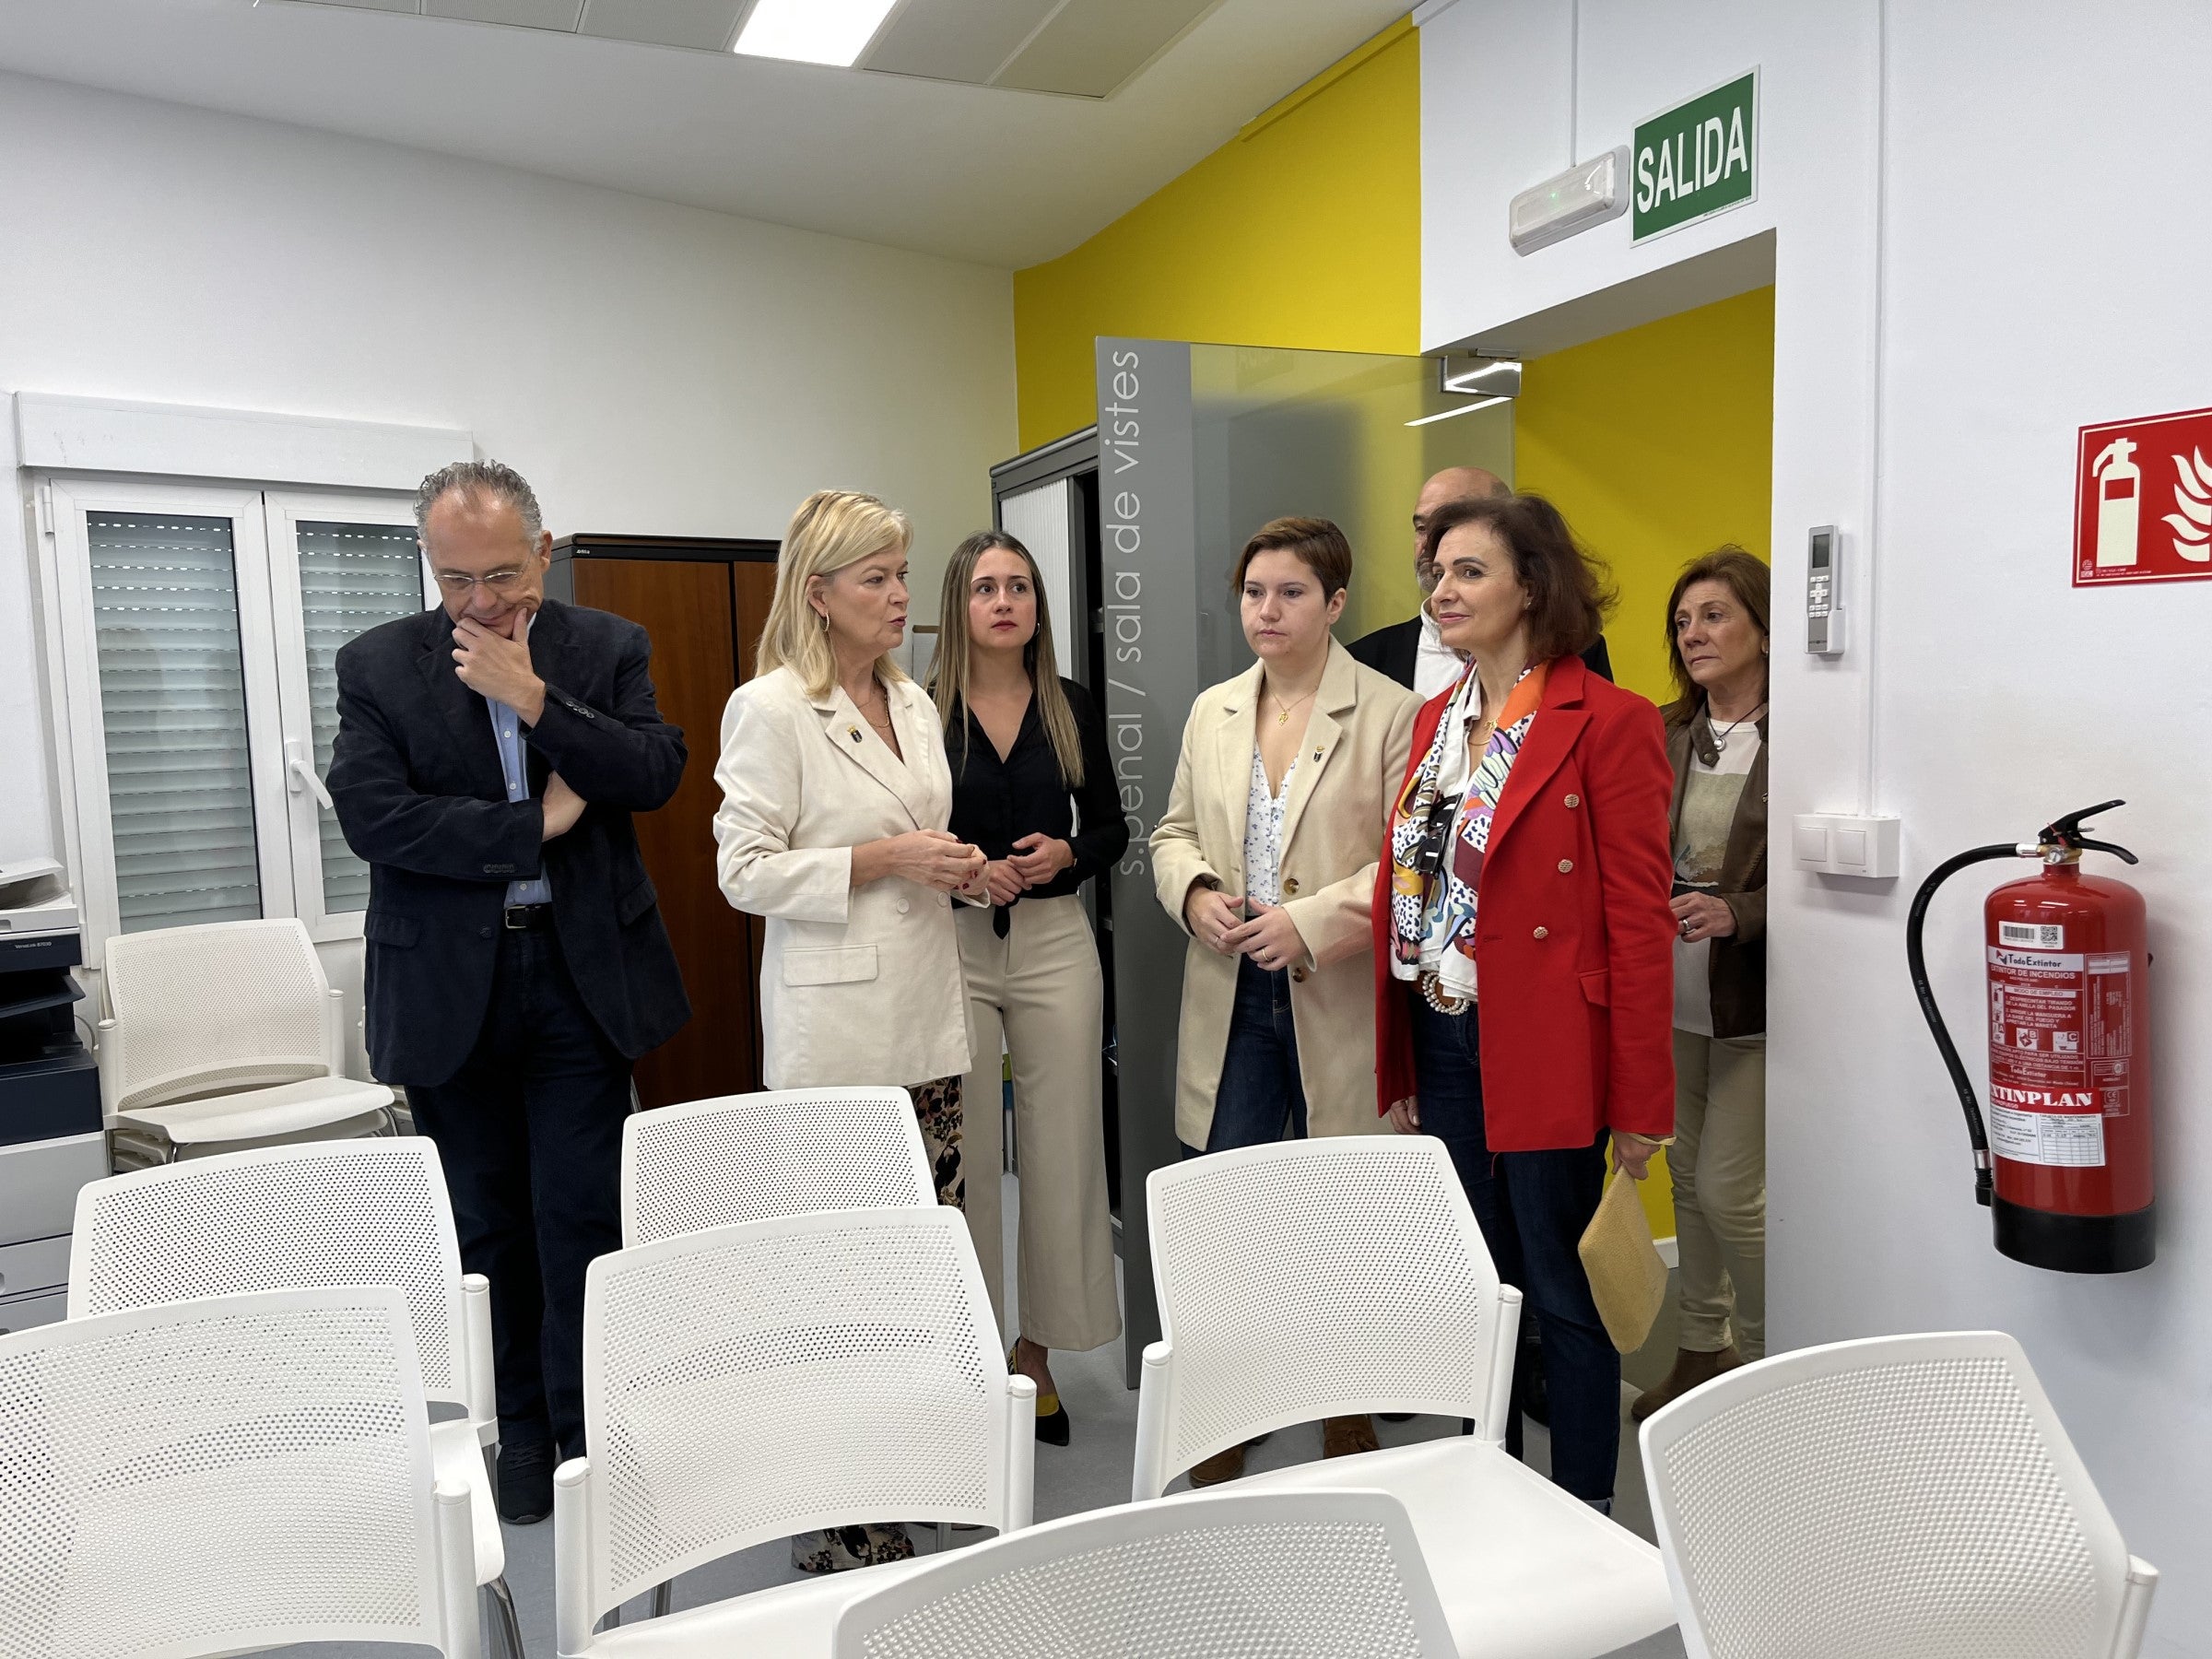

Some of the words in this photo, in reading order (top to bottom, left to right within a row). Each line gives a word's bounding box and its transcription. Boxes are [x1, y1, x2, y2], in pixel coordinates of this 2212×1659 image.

[1637, 106, 1748, 214] SALIDA
[1105, 350, 1139, 474] vistes
[1106, 491, 1141, 553] de
[1107, 571, 1142, 663] sala
[2008, 954, 2062, 968] TodoExtintor
[2018, 969, 2029, 977] DE
[2030, 971, 2076, 980] INCENDIOS
[2029, 1030, 2037, 1039] B
[2068, 1032, 2077, 1041] C
[1990, 1083, 2093, 1107] XTINPLAN
